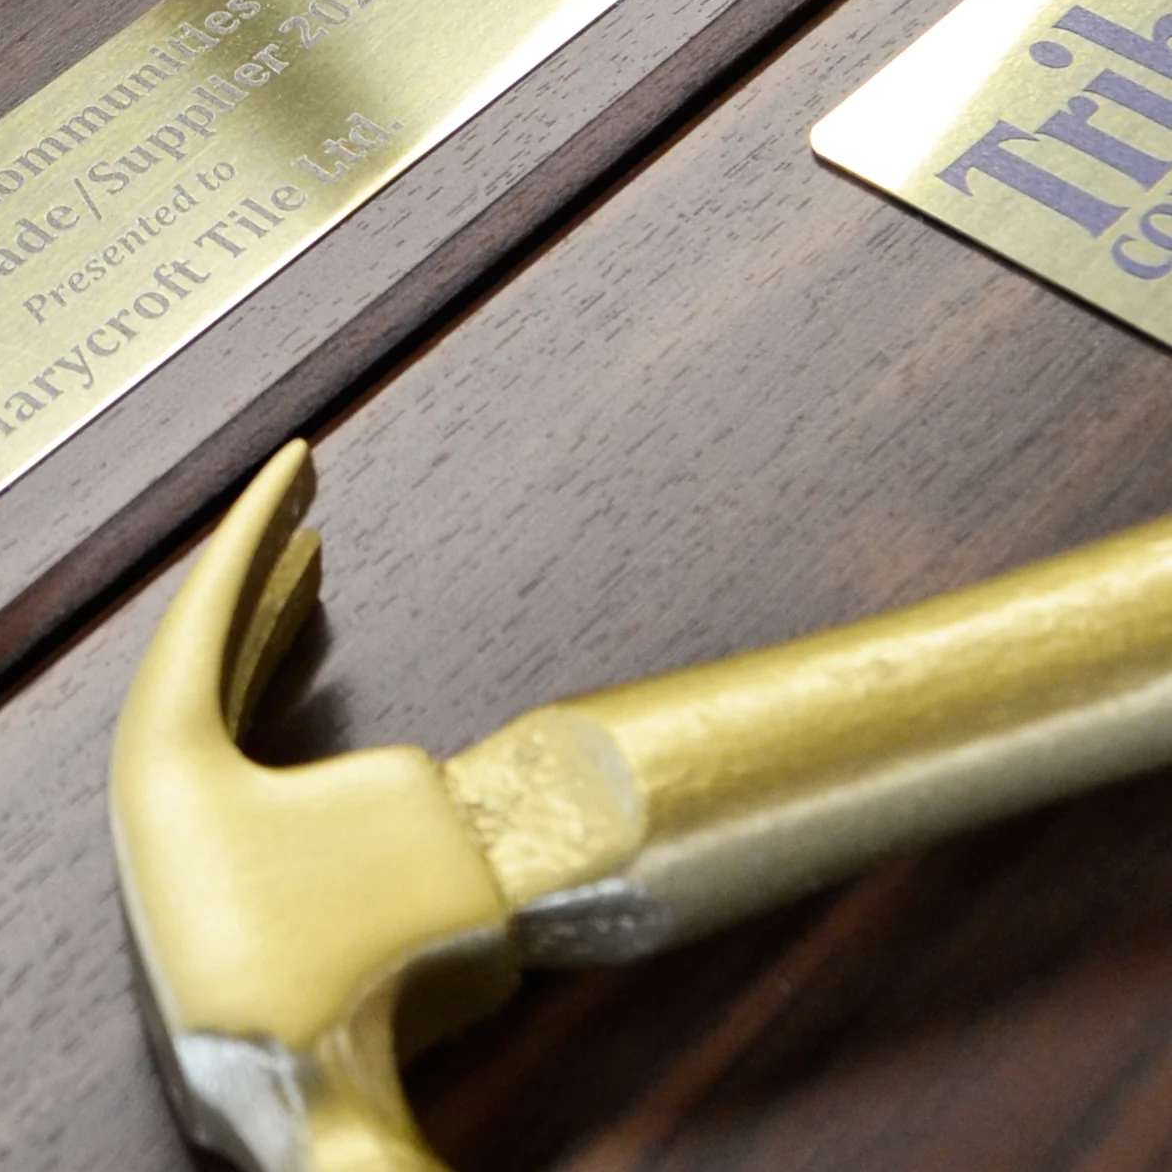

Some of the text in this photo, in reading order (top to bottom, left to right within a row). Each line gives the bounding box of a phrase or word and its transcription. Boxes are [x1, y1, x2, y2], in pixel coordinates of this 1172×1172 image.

[22, 158, 238, 326] Presented to
[194, 182, 309, 264] Tile
[292, 112, 403, 184] Ltd.
